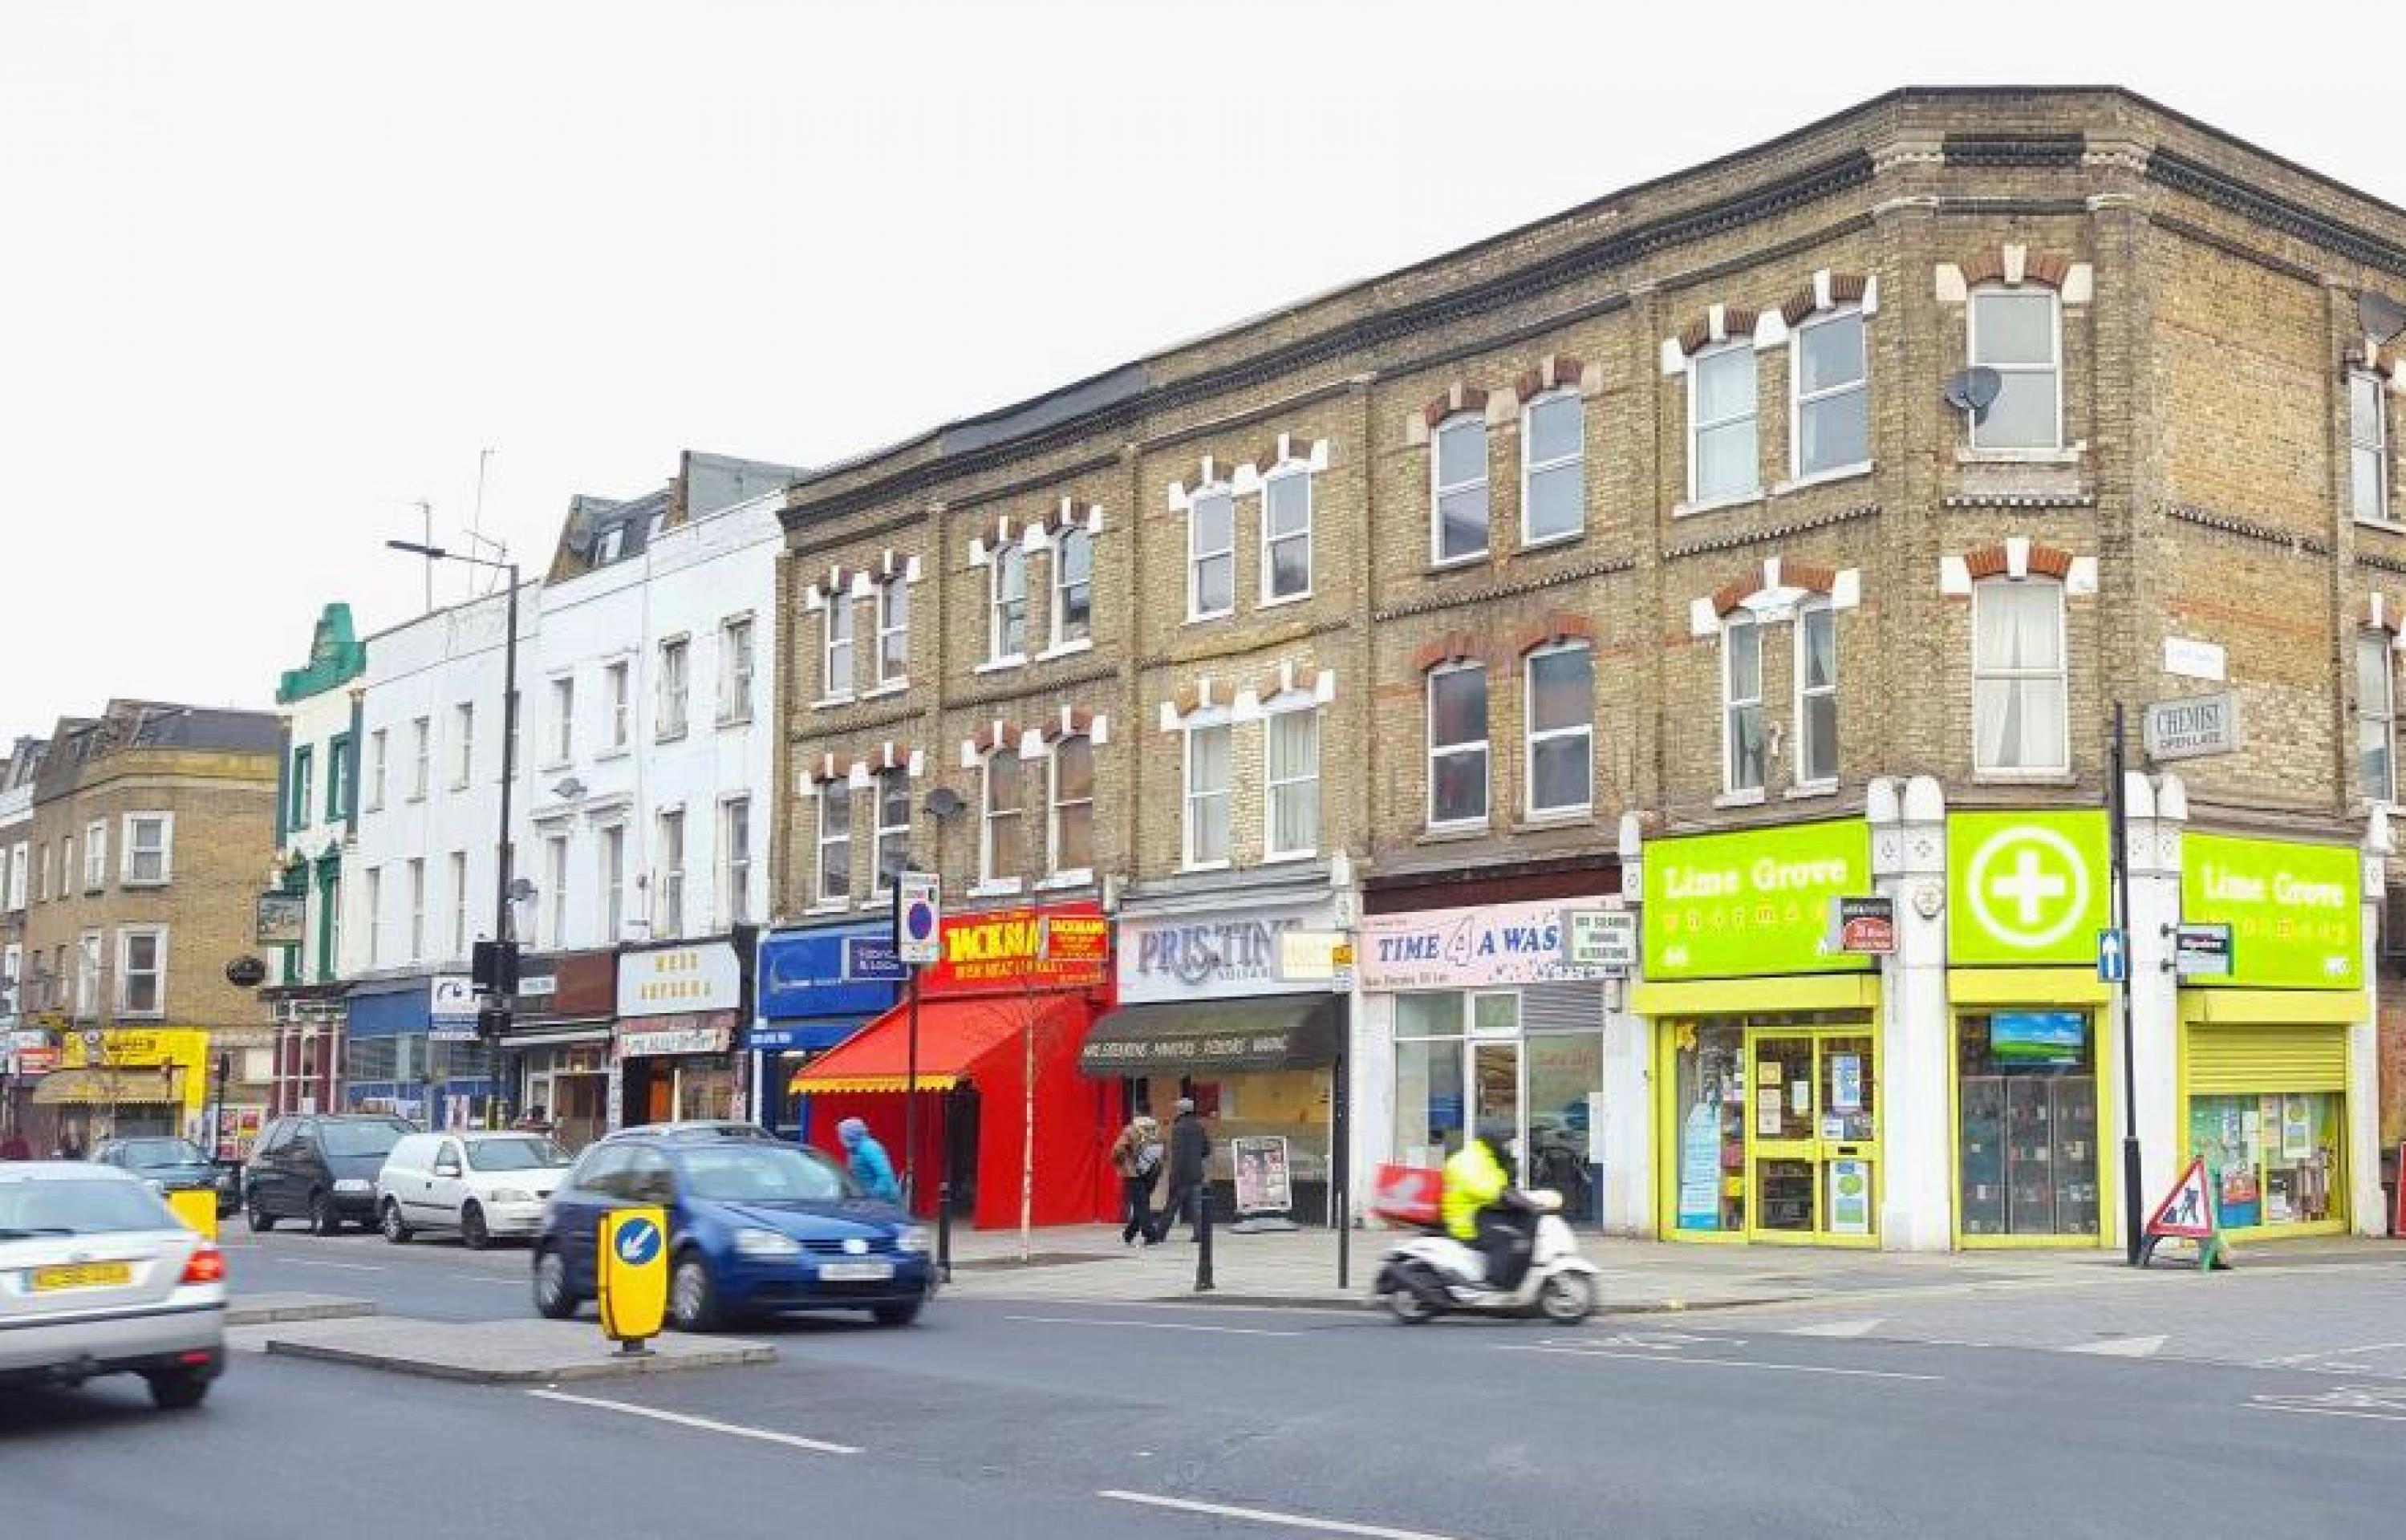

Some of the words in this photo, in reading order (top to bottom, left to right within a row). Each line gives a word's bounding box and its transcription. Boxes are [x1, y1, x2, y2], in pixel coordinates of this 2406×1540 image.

[2157, 704, 2220, 735] CHEMIST
[1663, 866, 1740, 898] Lime
[1751, 857, 1848, 891] Grove
[2201, 864, 2266, 902] Lime
[2273, 871, 2346, 909] Grove
[1137, 918, 1302, 986] PRISTIN
[1377, 933, 1440, 962] TIME
[1477, 931, 1495, 956] A
[1501, 924, 1560, 954] WAS
